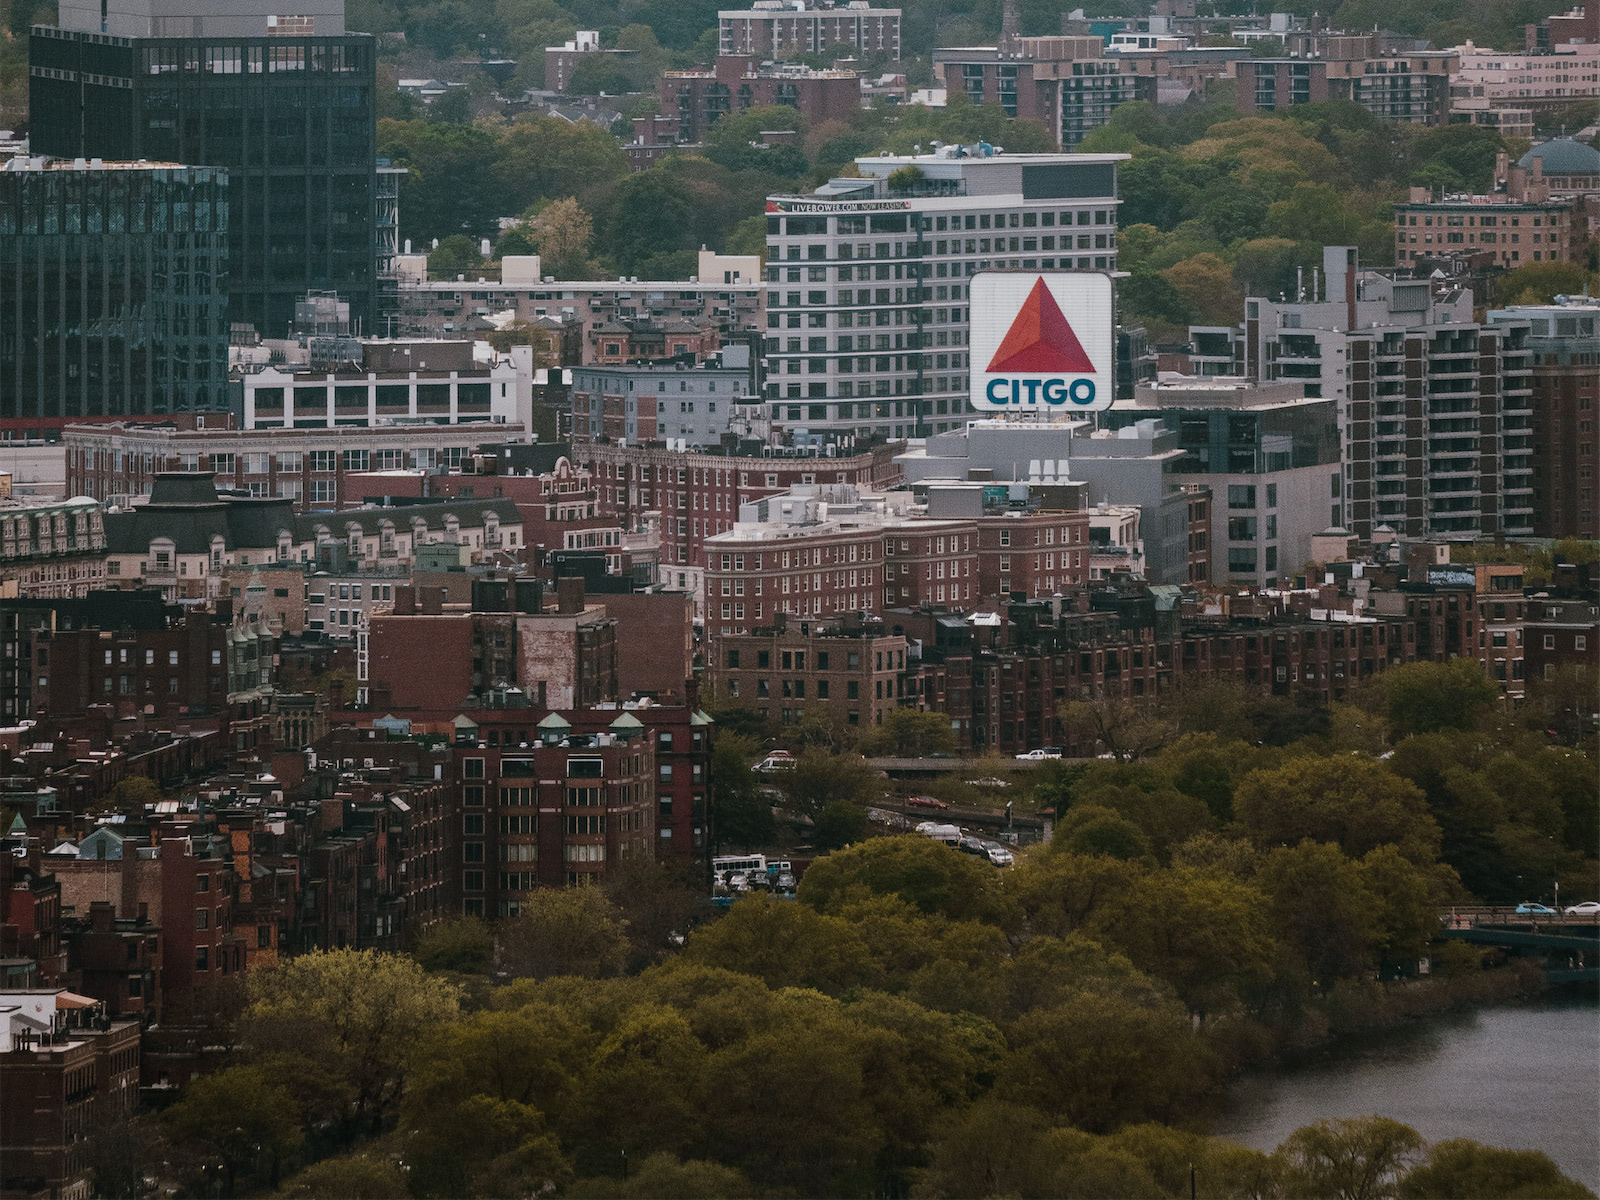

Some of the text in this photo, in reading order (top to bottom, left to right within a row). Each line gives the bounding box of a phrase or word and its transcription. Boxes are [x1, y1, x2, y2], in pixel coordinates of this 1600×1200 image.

[791, 201, 904, 212] LIVEBOWER.COM NOW LEASING
[986, 378, 1096, 405] CITGO
